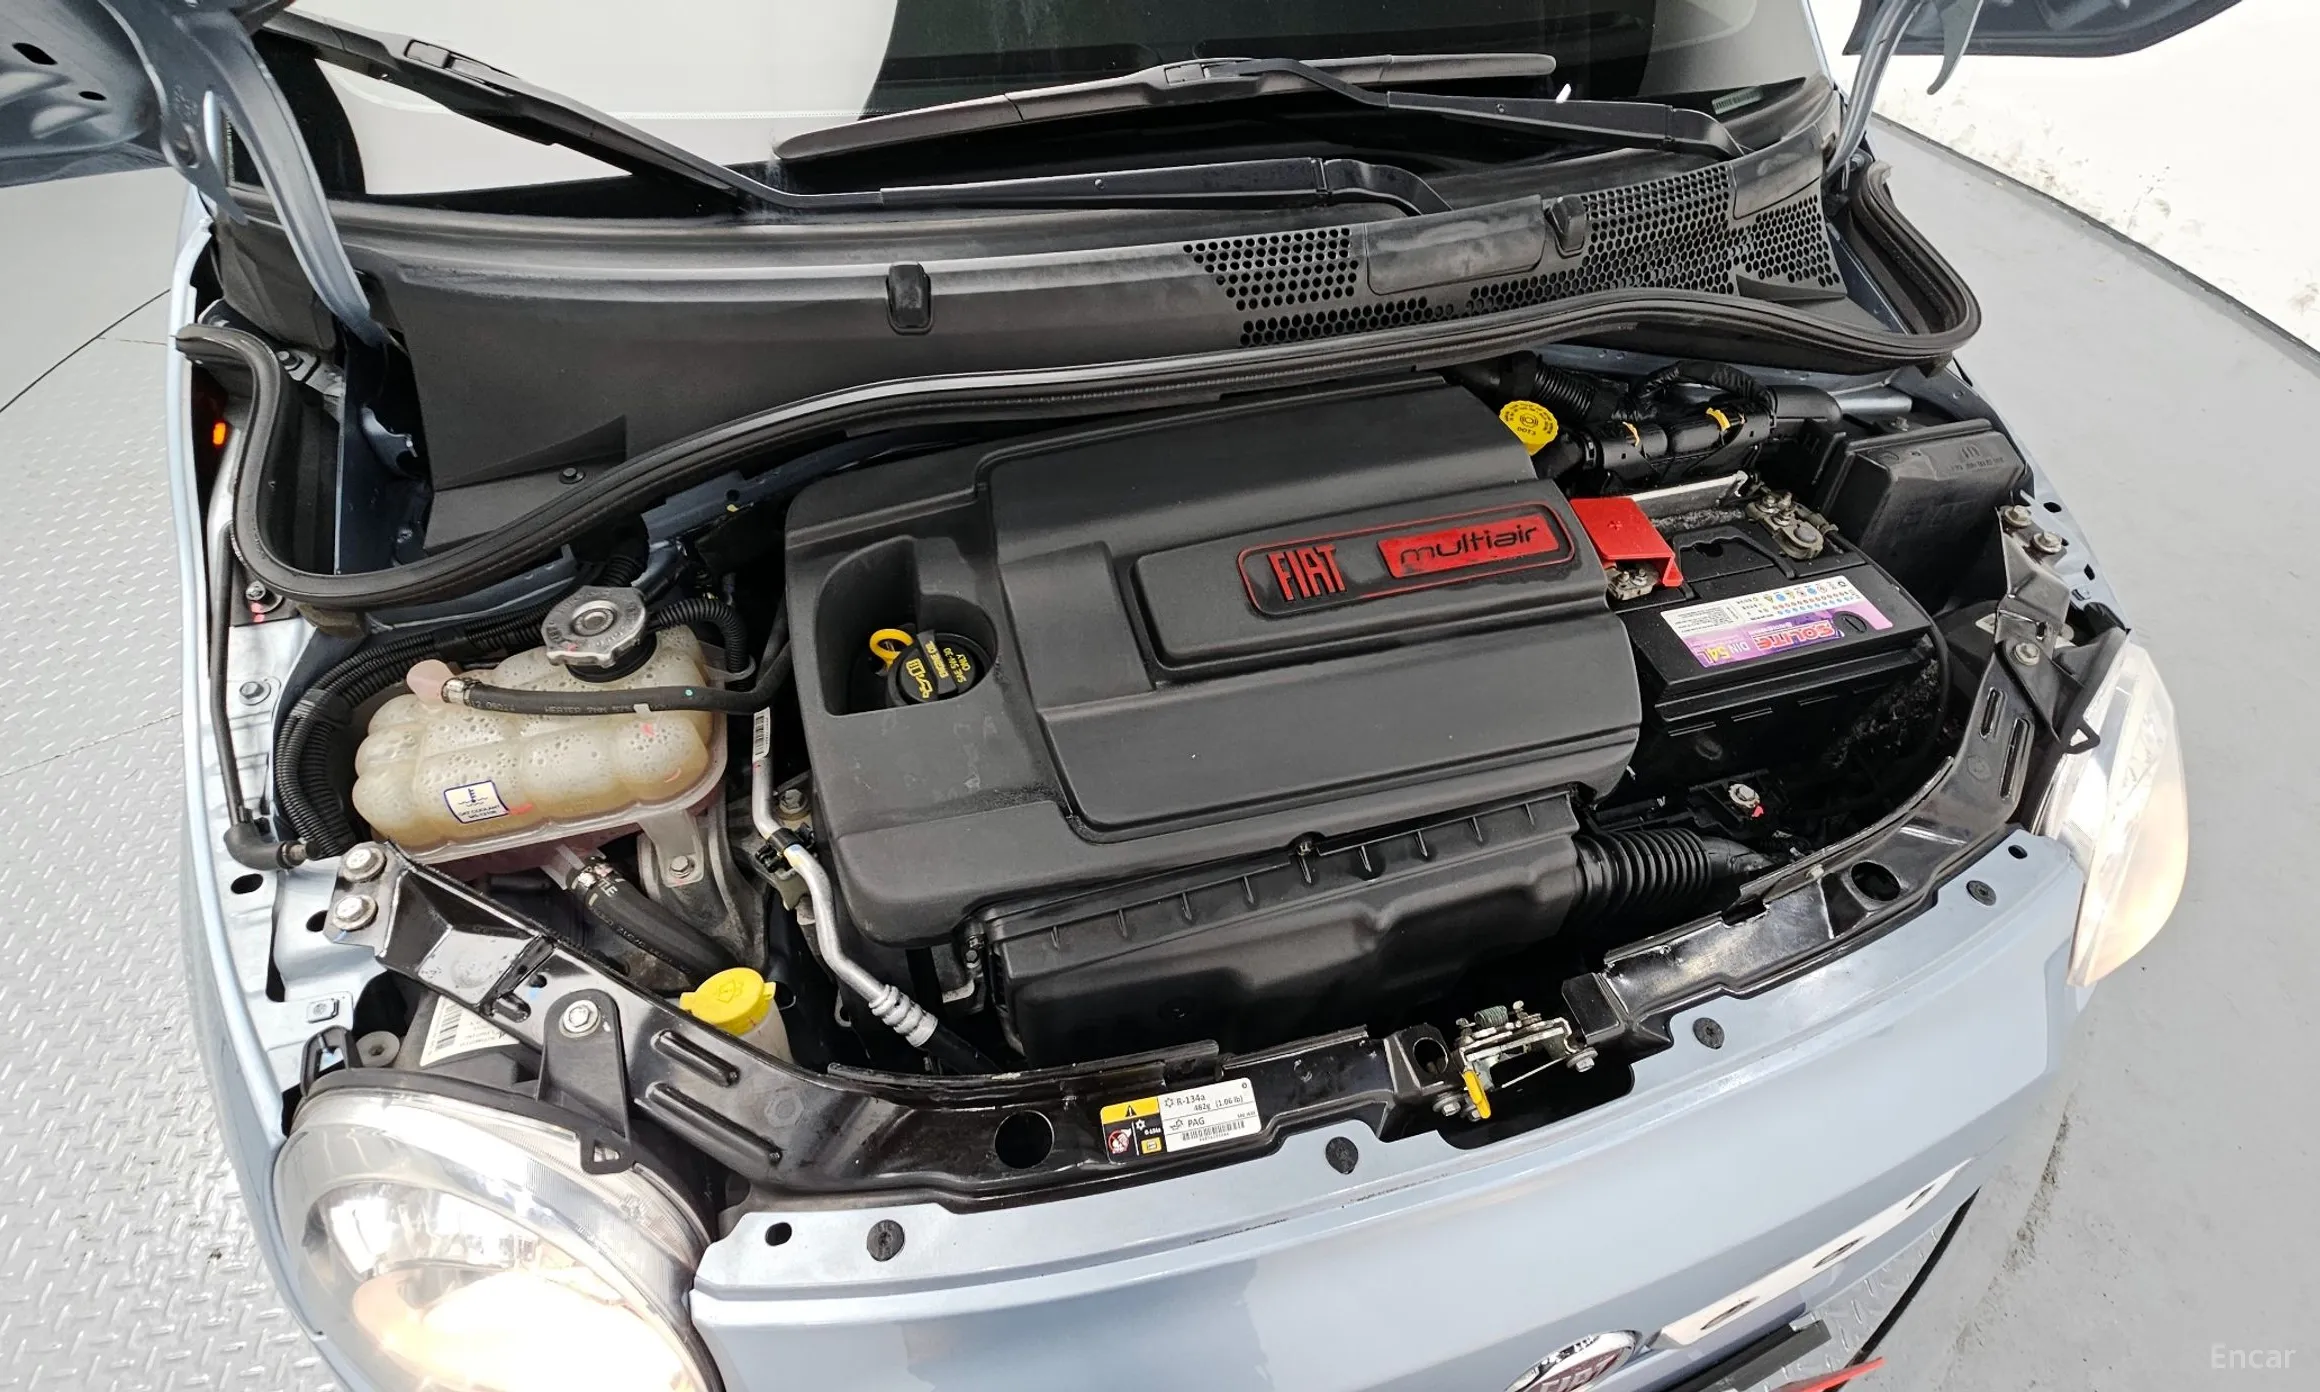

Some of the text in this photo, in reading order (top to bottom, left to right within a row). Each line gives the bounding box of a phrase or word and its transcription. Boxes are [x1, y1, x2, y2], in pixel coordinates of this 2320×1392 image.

[1400, 524, 1539, 565] multiair
[1267, 543, 1347, 602] FIAT
[1756, 623, 1834, 650] SOLITE
[1728, 641, 1751, 654] DIN
[925, 640, 949, 679] ENGINE OIL
[956, 654, 971, 671] ONLY
[953, 668, 967, 683] SAE
[1176, 1093, 1206, 1106] R-134a
[1187, 1116, 1205, 1127] PAG
